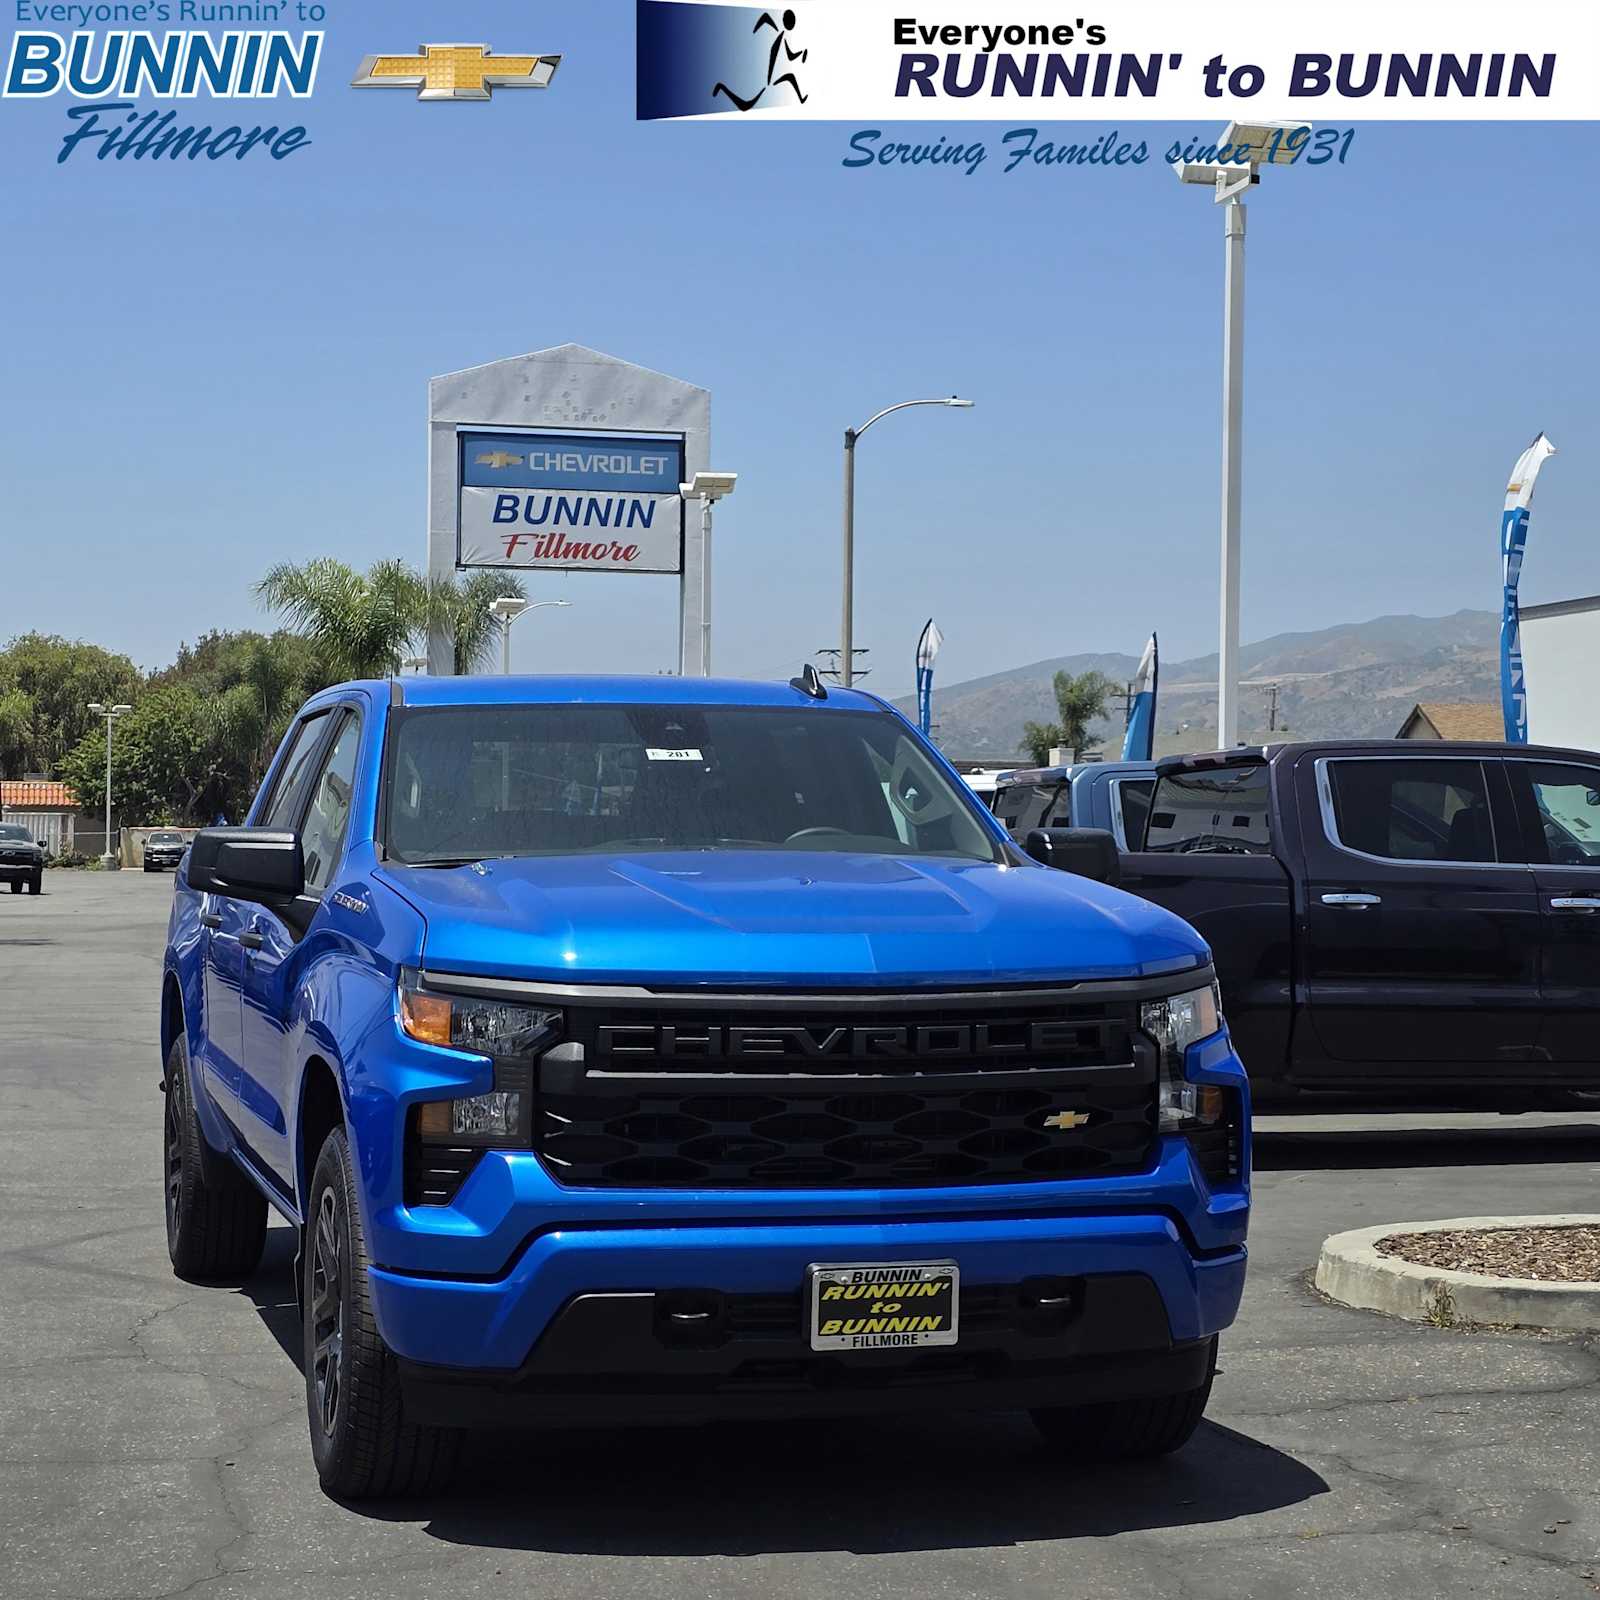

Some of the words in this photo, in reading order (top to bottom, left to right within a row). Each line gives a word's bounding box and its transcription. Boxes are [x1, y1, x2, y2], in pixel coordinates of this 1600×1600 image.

[529, 452, 668, 475] CHEVROLET
[492, 494, 656, 528] BUNNIN
[500, 533, 640, 562] Fillmore
[597, 1019, 1126, 1058] CHEVROLET
[851, 1269, 922, 1283] BUNNIN
[820, 1282, 950, 1301] RUNNIN'
[870, 1301, 902, 1313] to
[819, 1315, 943, 1335] BUNNIN
[852, 1333, 918, 1347] FILLMORE
